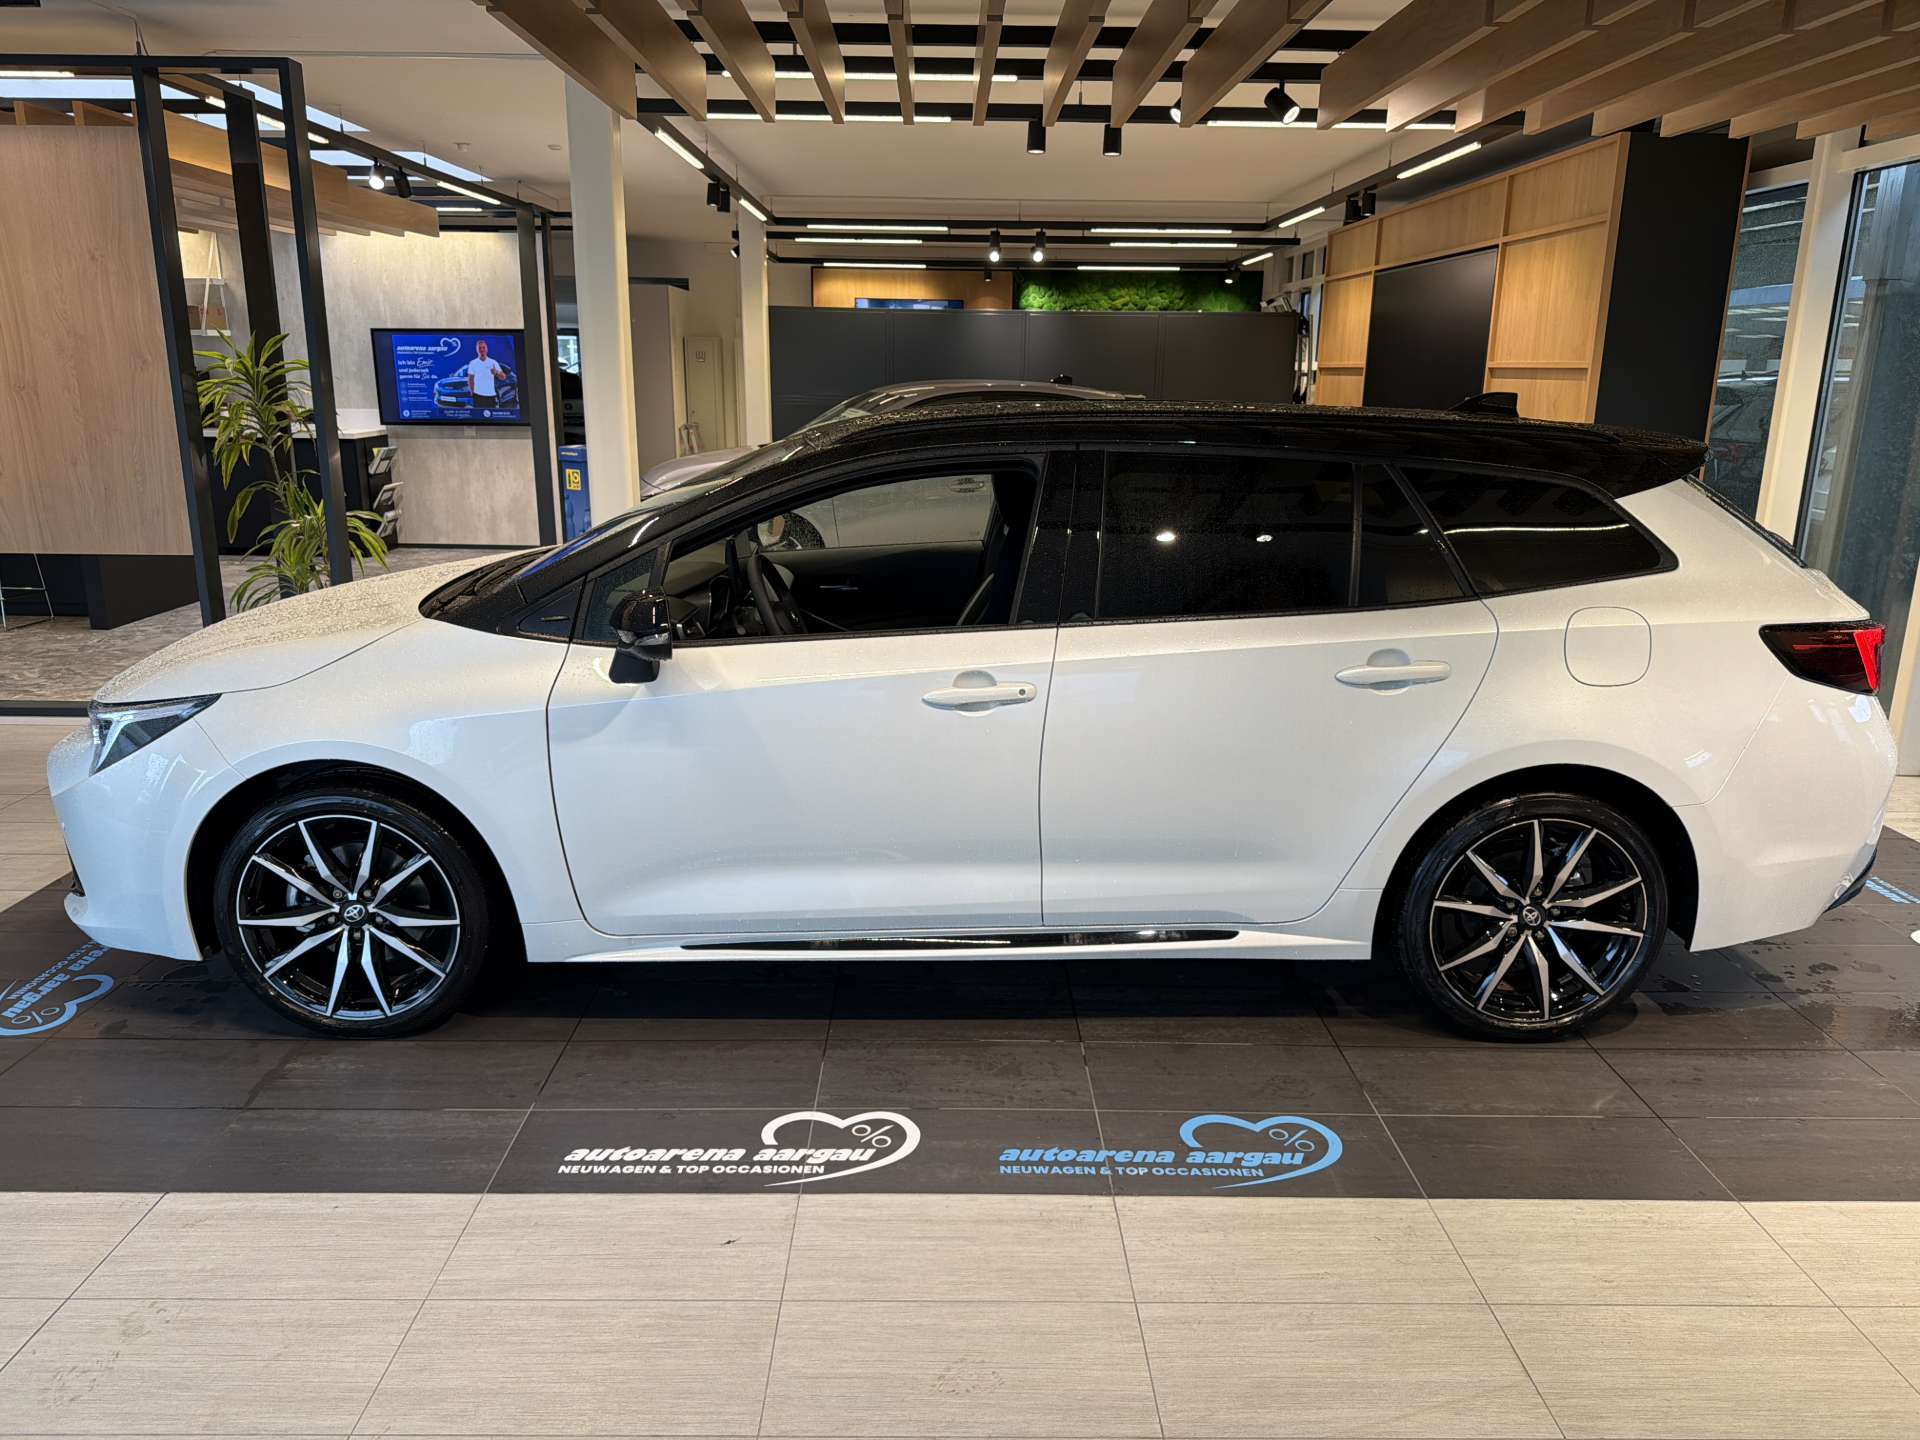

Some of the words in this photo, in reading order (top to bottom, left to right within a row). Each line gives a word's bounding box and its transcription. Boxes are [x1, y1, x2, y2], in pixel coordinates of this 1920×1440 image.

[1, 973, 72, 1019] aargau
[563, 1146, 746, 1162] autoarena
[752, 1148, 877, 1164] aargau
[999, 1147, 1176, 1163] autoarena
[1185, 1150, 1305, 1167] aargau
[557, 1165, 657, 1174] NEUWAGEN
[658, 1165, 672, 1174] &
[676, 1165, 710, 1174] TOP
[712, 1165, 825, 1174] OCCASIONEN
[999, 1165, 1097, 1175] NEUWAGEN
[1099, 1166, 1112, 1175] &
[1114, 1166, 1149, 1176] TOP
[1151, 1167, 1265, 1177] OCCASIONEN
